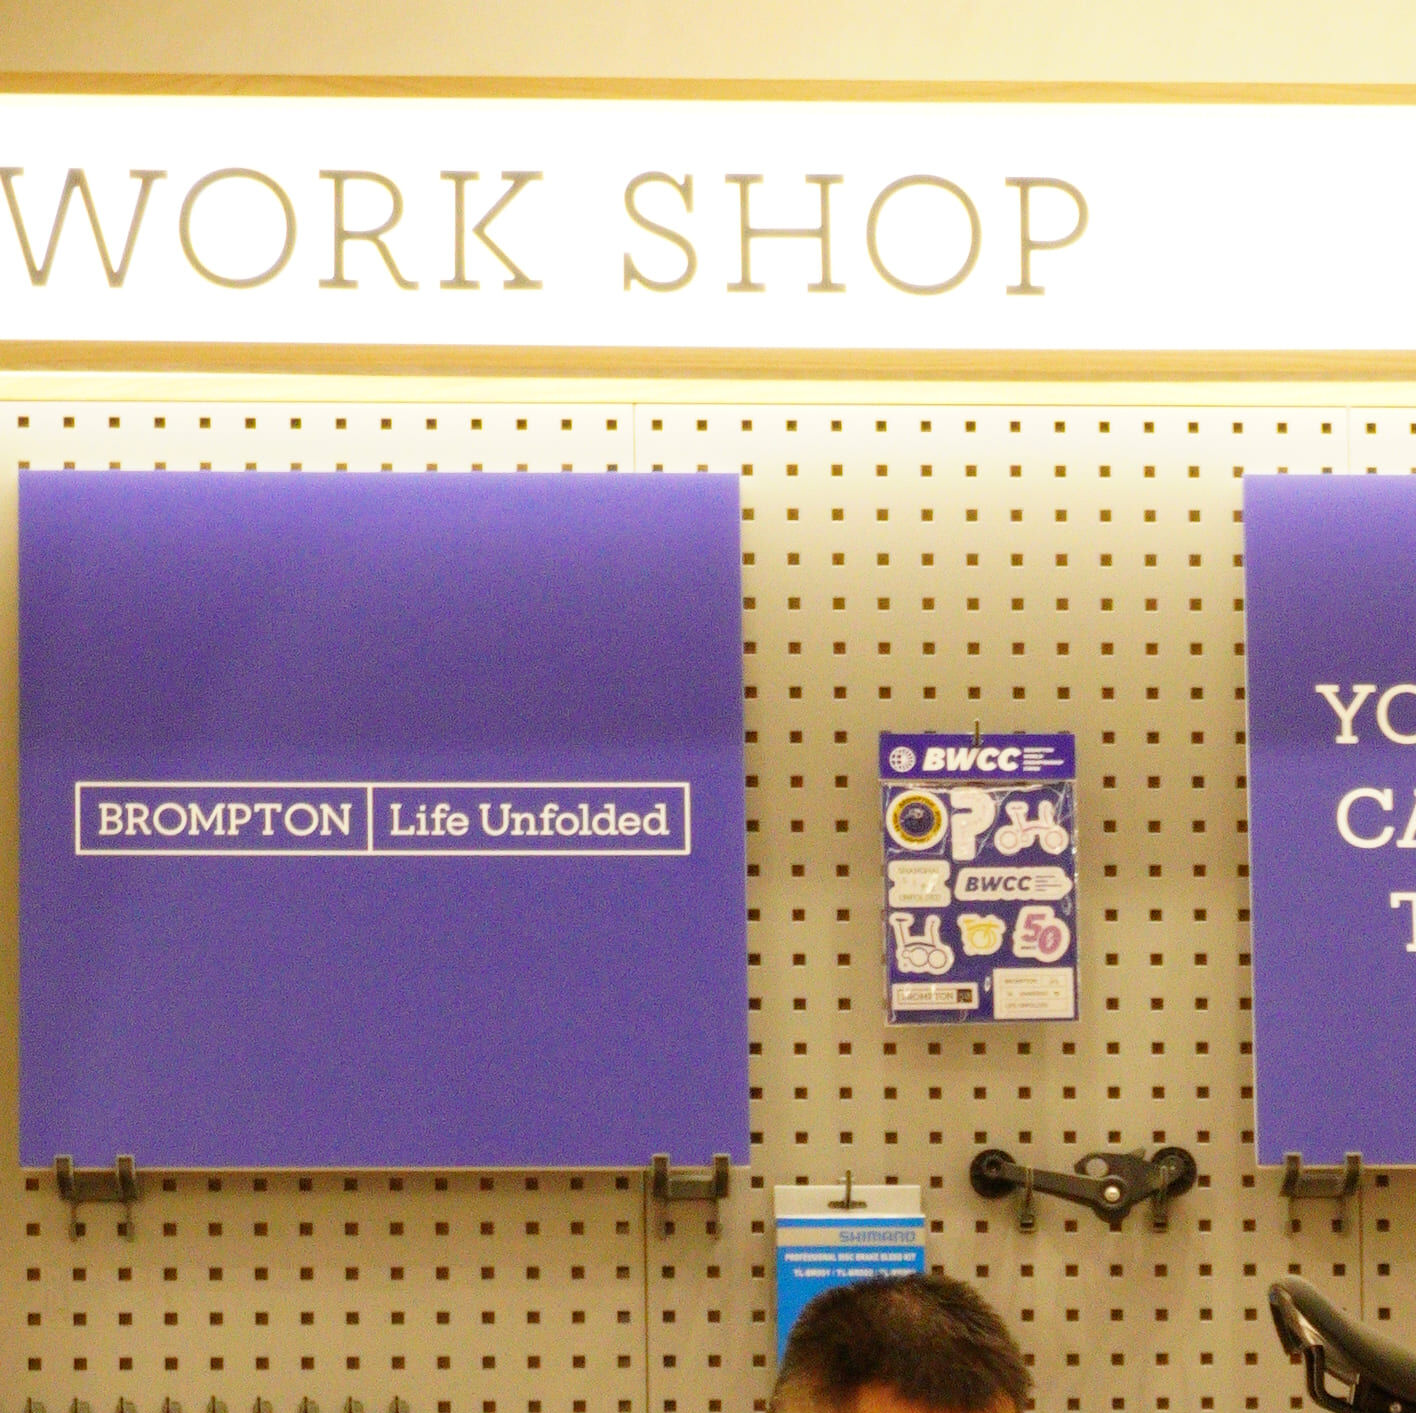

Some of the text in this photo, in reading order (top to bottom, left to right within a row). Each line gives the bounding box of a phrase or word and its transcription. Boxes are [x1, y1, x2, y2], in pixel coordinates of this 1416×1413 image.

[0, 166, 1089, 297] WORK SHOP
[922, 747, 1022, 772] BWCC
[97, 801, 670, 836] BROMPTON Life Unfolded
[965, 876, 1032, 892] BWCC
[1022, 913, 1062, 955] 50
[839, 1230, 916, 1242] SHIMANO
